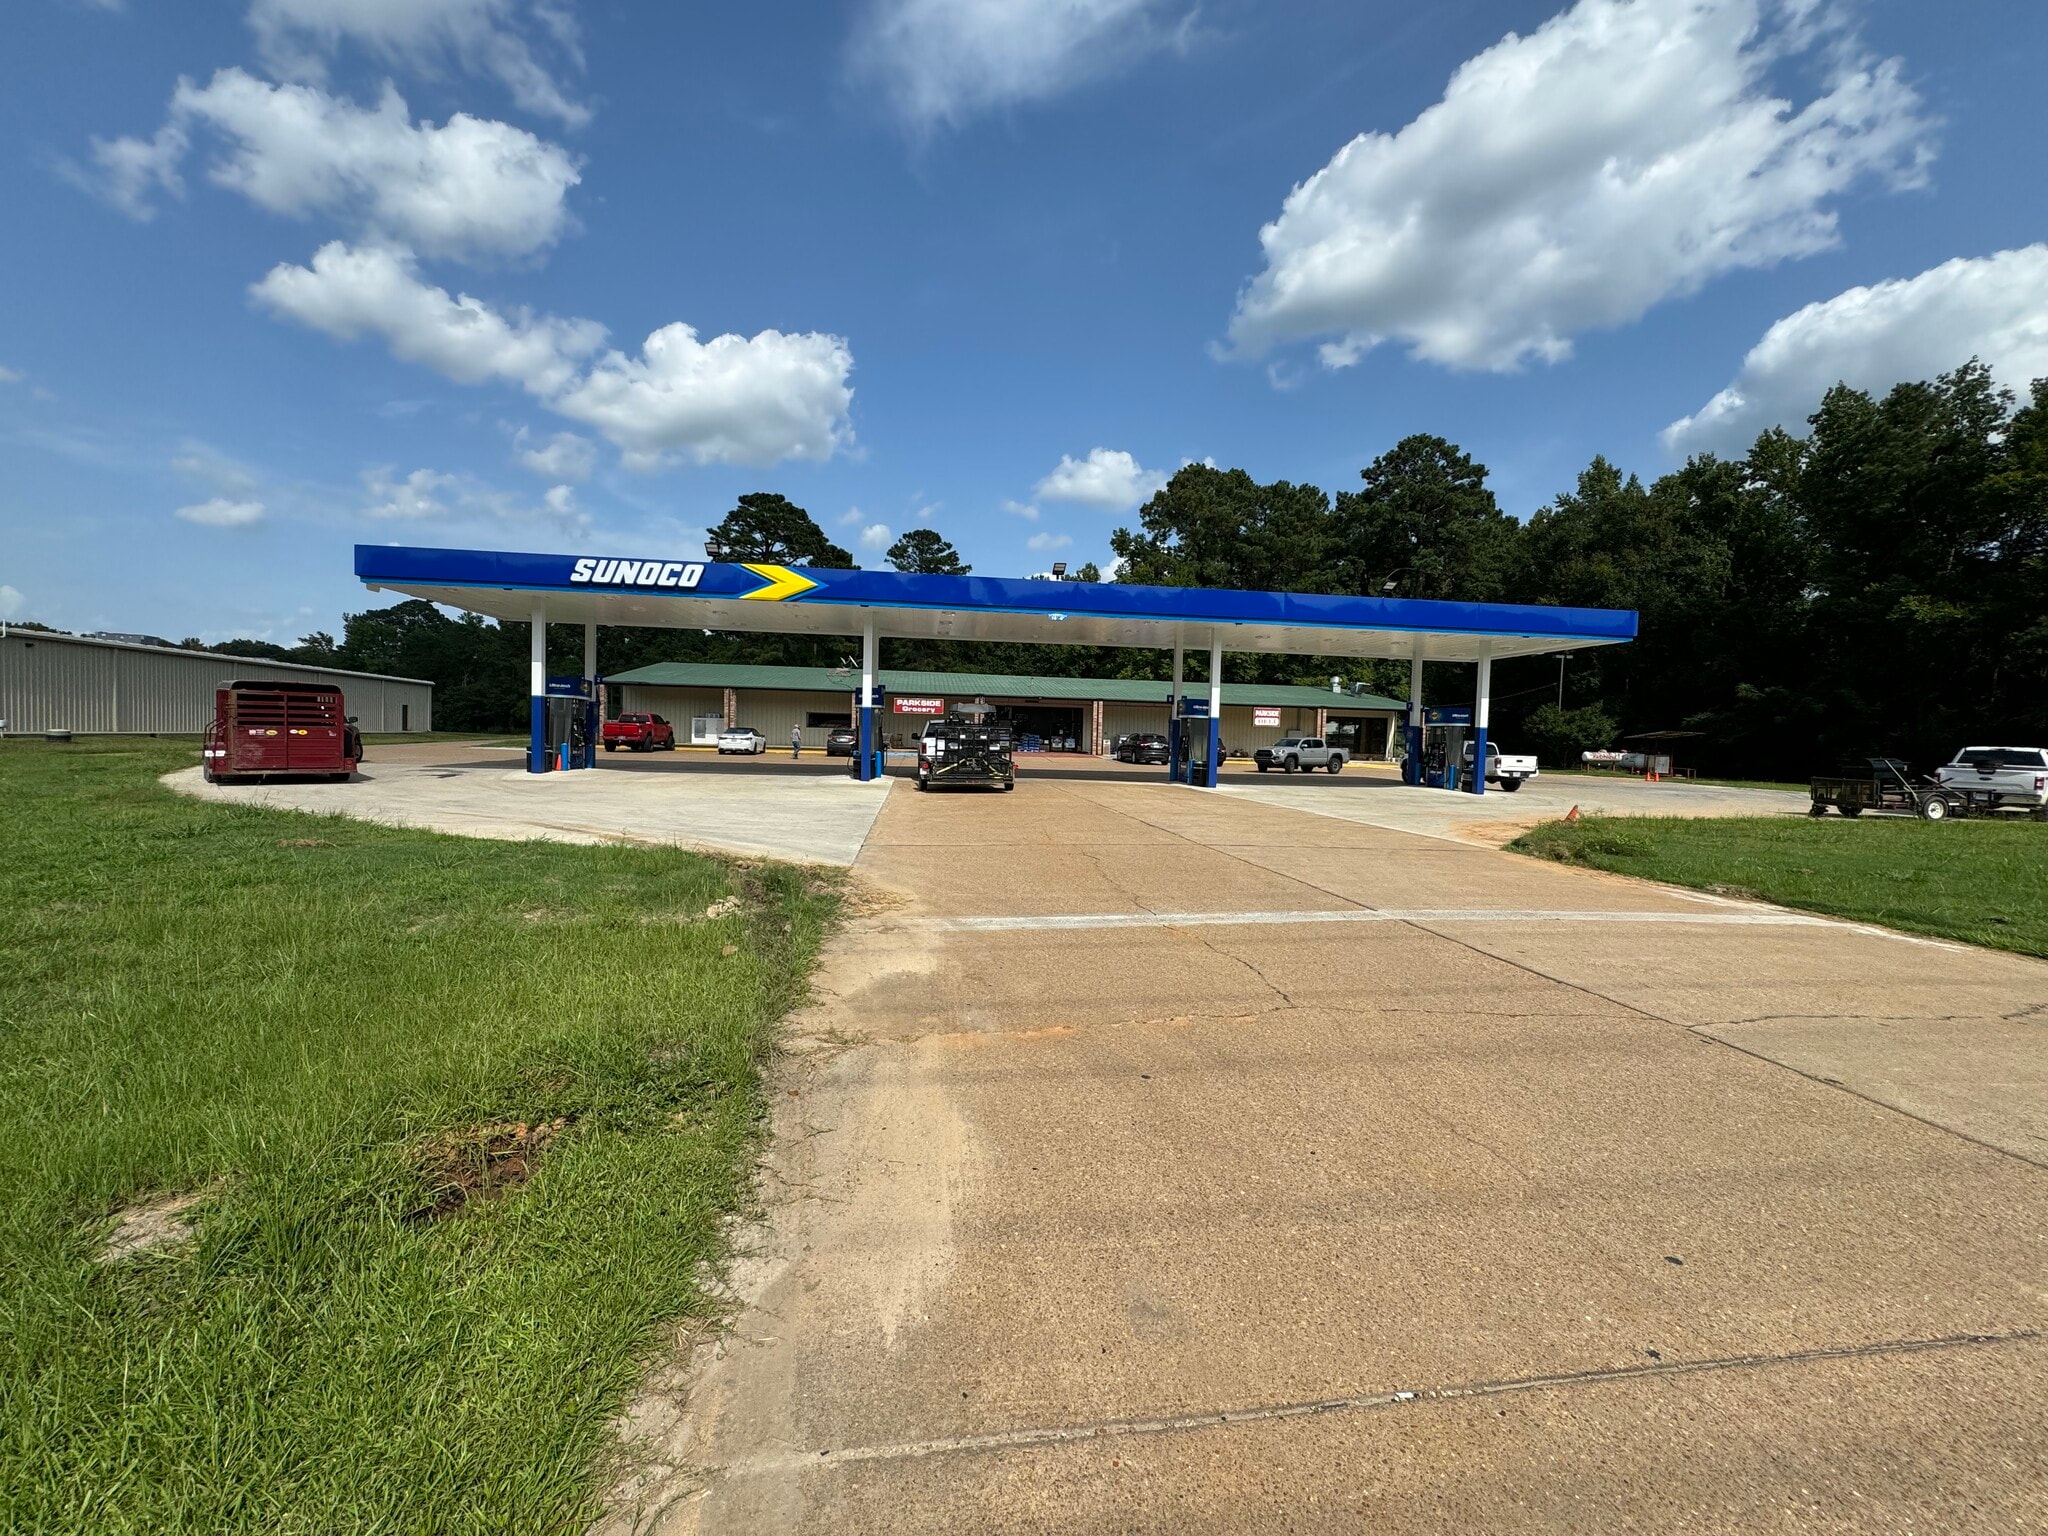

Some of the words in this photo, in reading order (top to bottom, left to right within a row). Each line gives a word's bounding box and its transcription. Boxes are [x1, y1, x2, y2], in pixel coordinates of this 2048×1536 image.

[570, 558, 704, 587] SUNOCO
[896, 699, 941, 707] PARKSIDE
[902, 706, 936, 714] Grocery
[1255, 710, 1279, 718] PARKSIDE
